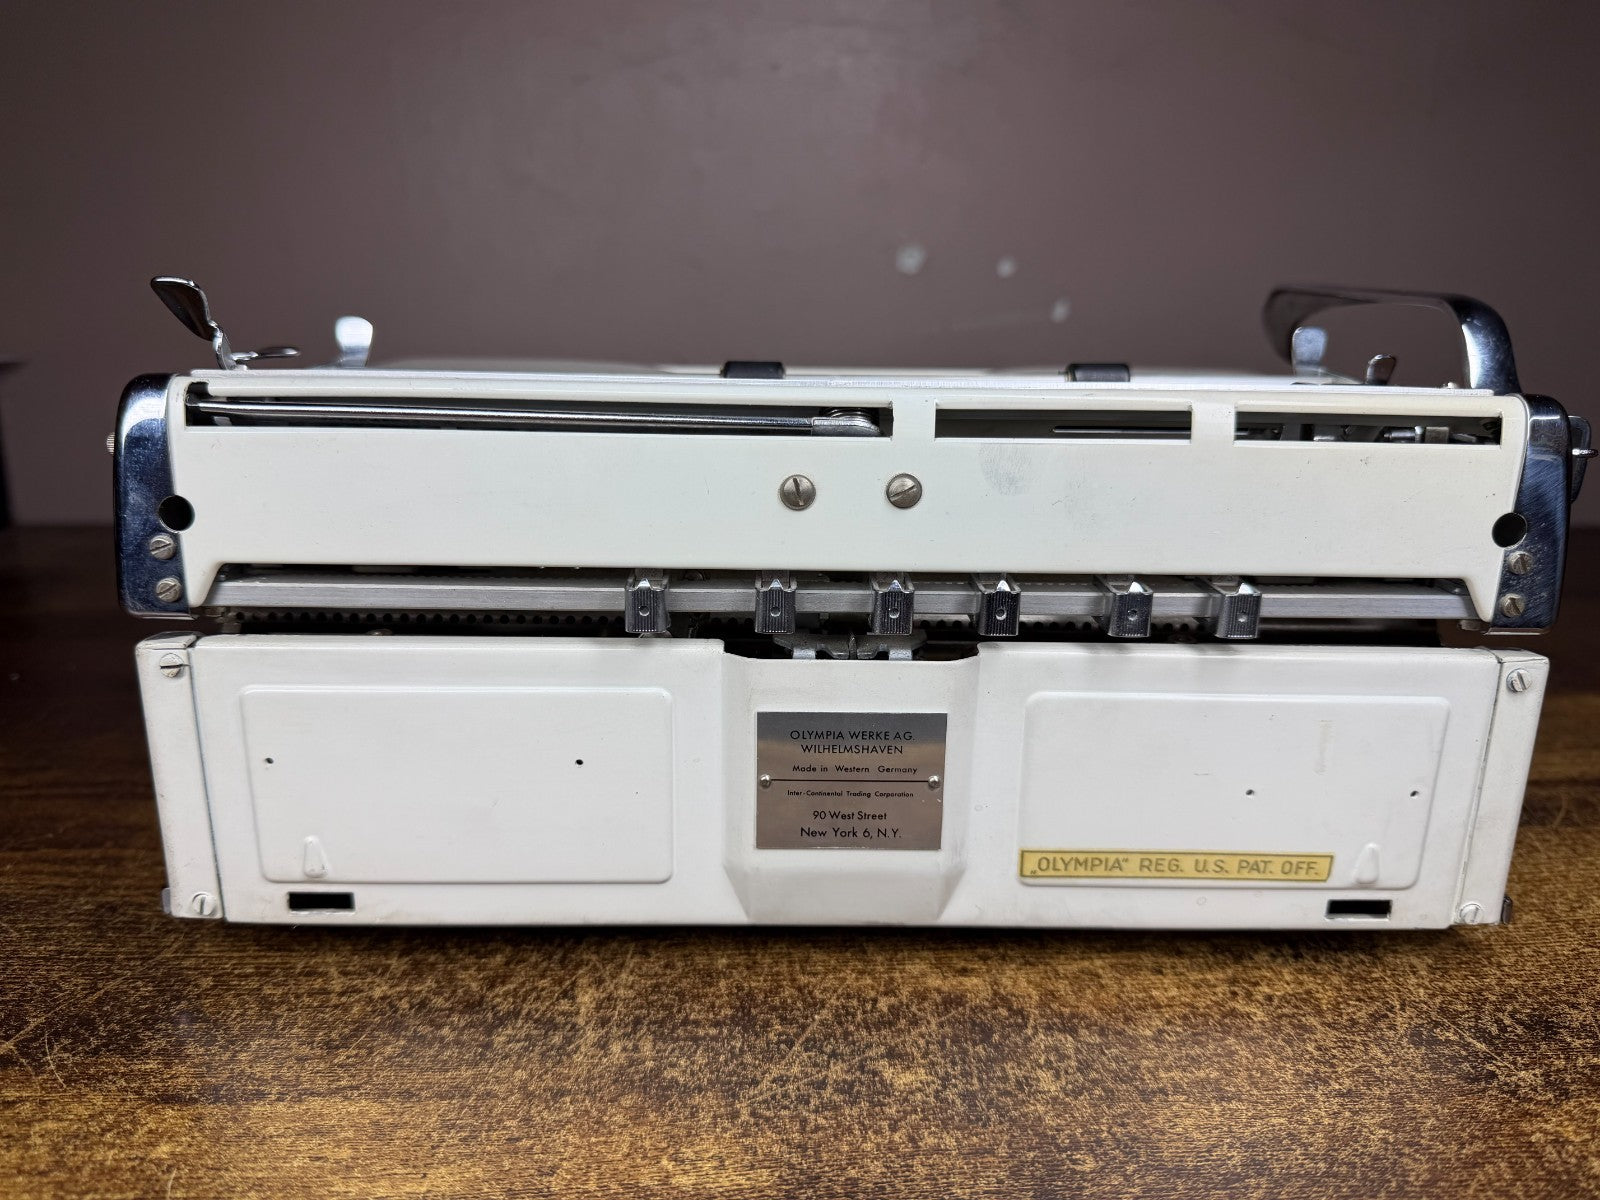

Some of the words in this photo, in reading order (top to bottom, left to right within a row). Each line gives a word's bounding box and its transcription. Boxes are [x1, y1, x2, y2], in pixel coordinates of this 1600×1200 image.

[789, 730, 845, 741] OLYMPIA
[848, 730, 890, 741] WERKE
[893, 731, 916, 741] AG.
[800, 744, 904, 755] WILHELMSHAVEN
[792, 764, 817, 773] Made
[820, 764, 828, 773] in
[834, 764, 870, 773] Western
[877, 765, 918, 775] Germany
[787, 789, 843, 797] Inter-Continental
[846, 790, 872, 799] Trading
[874, 790, 914, 799] Corporation
[812, 810, 827, 820] 90
[828, 810, 855, 820] West
[857, 810, 887, 820] Street
[800, 827, 828, 838] New
[832, 826, 858, 838] York
[862, 828, 873, 840] 6,
[877, 828, 902, 838] N.Y.
[1139, 857, 1184, 873] REG.
[1194, 858, 1229, 874] U.S.
[1236, 859, 1273, 874] PAT.
[1280, 860, 1319, 875] OFF.
